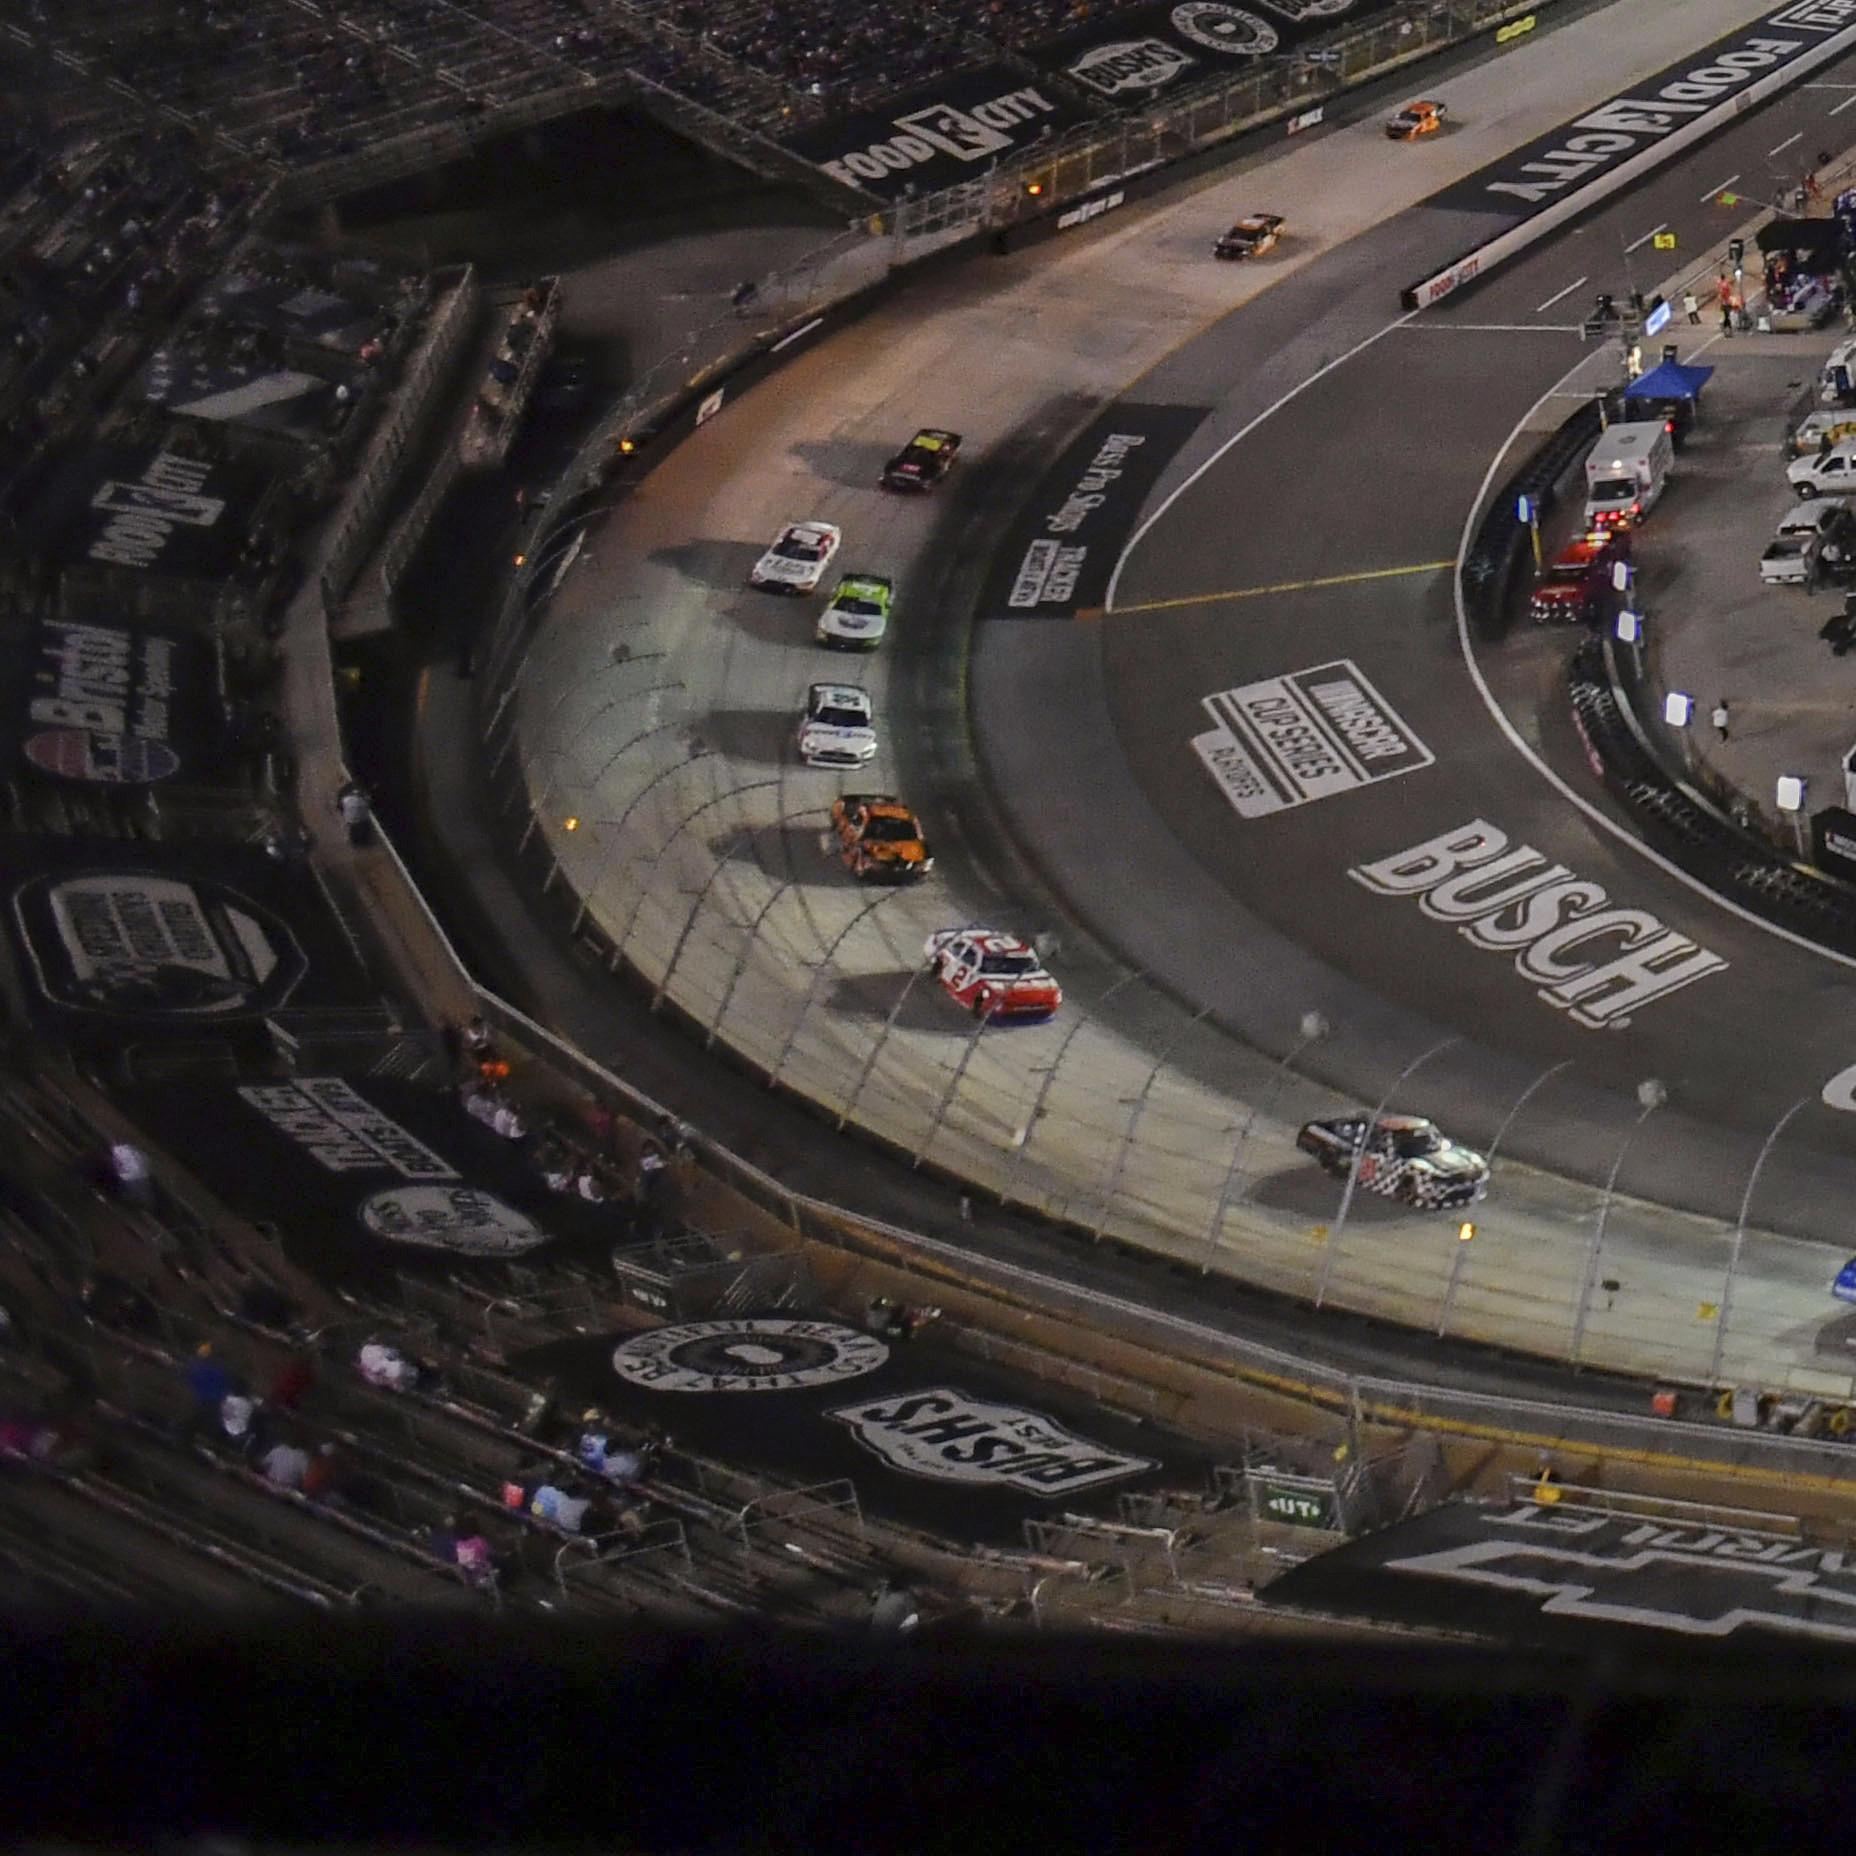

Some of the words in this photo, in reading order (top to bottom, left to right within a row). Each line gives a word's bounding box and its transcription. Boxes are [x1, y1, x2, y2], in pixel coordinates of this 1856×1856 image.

[1077, 43, 1182, 88] BUSH'S
[1660, 38, 1803, 104] FOOD
[819, 135, 937, 187] FOOD
[973, 85, 1057, 132] CITY
[1486, 130, 1636, 202] CITY
[1040, 545, 1087, 603] TRACKER
[1247, 697, 1295, 730] CUP
[1272, 718, 1342, 782] SERIES
[1321, 687, 1409, 761] NASCAR
[1207, 746, 1265, 800] PLAYOFFS
[1348, 818, 1731, 1030] BUSCH
[861, 1395, 1120, 1484] BUSH'S
[1000, 1414, 1069, 1450] BEST
